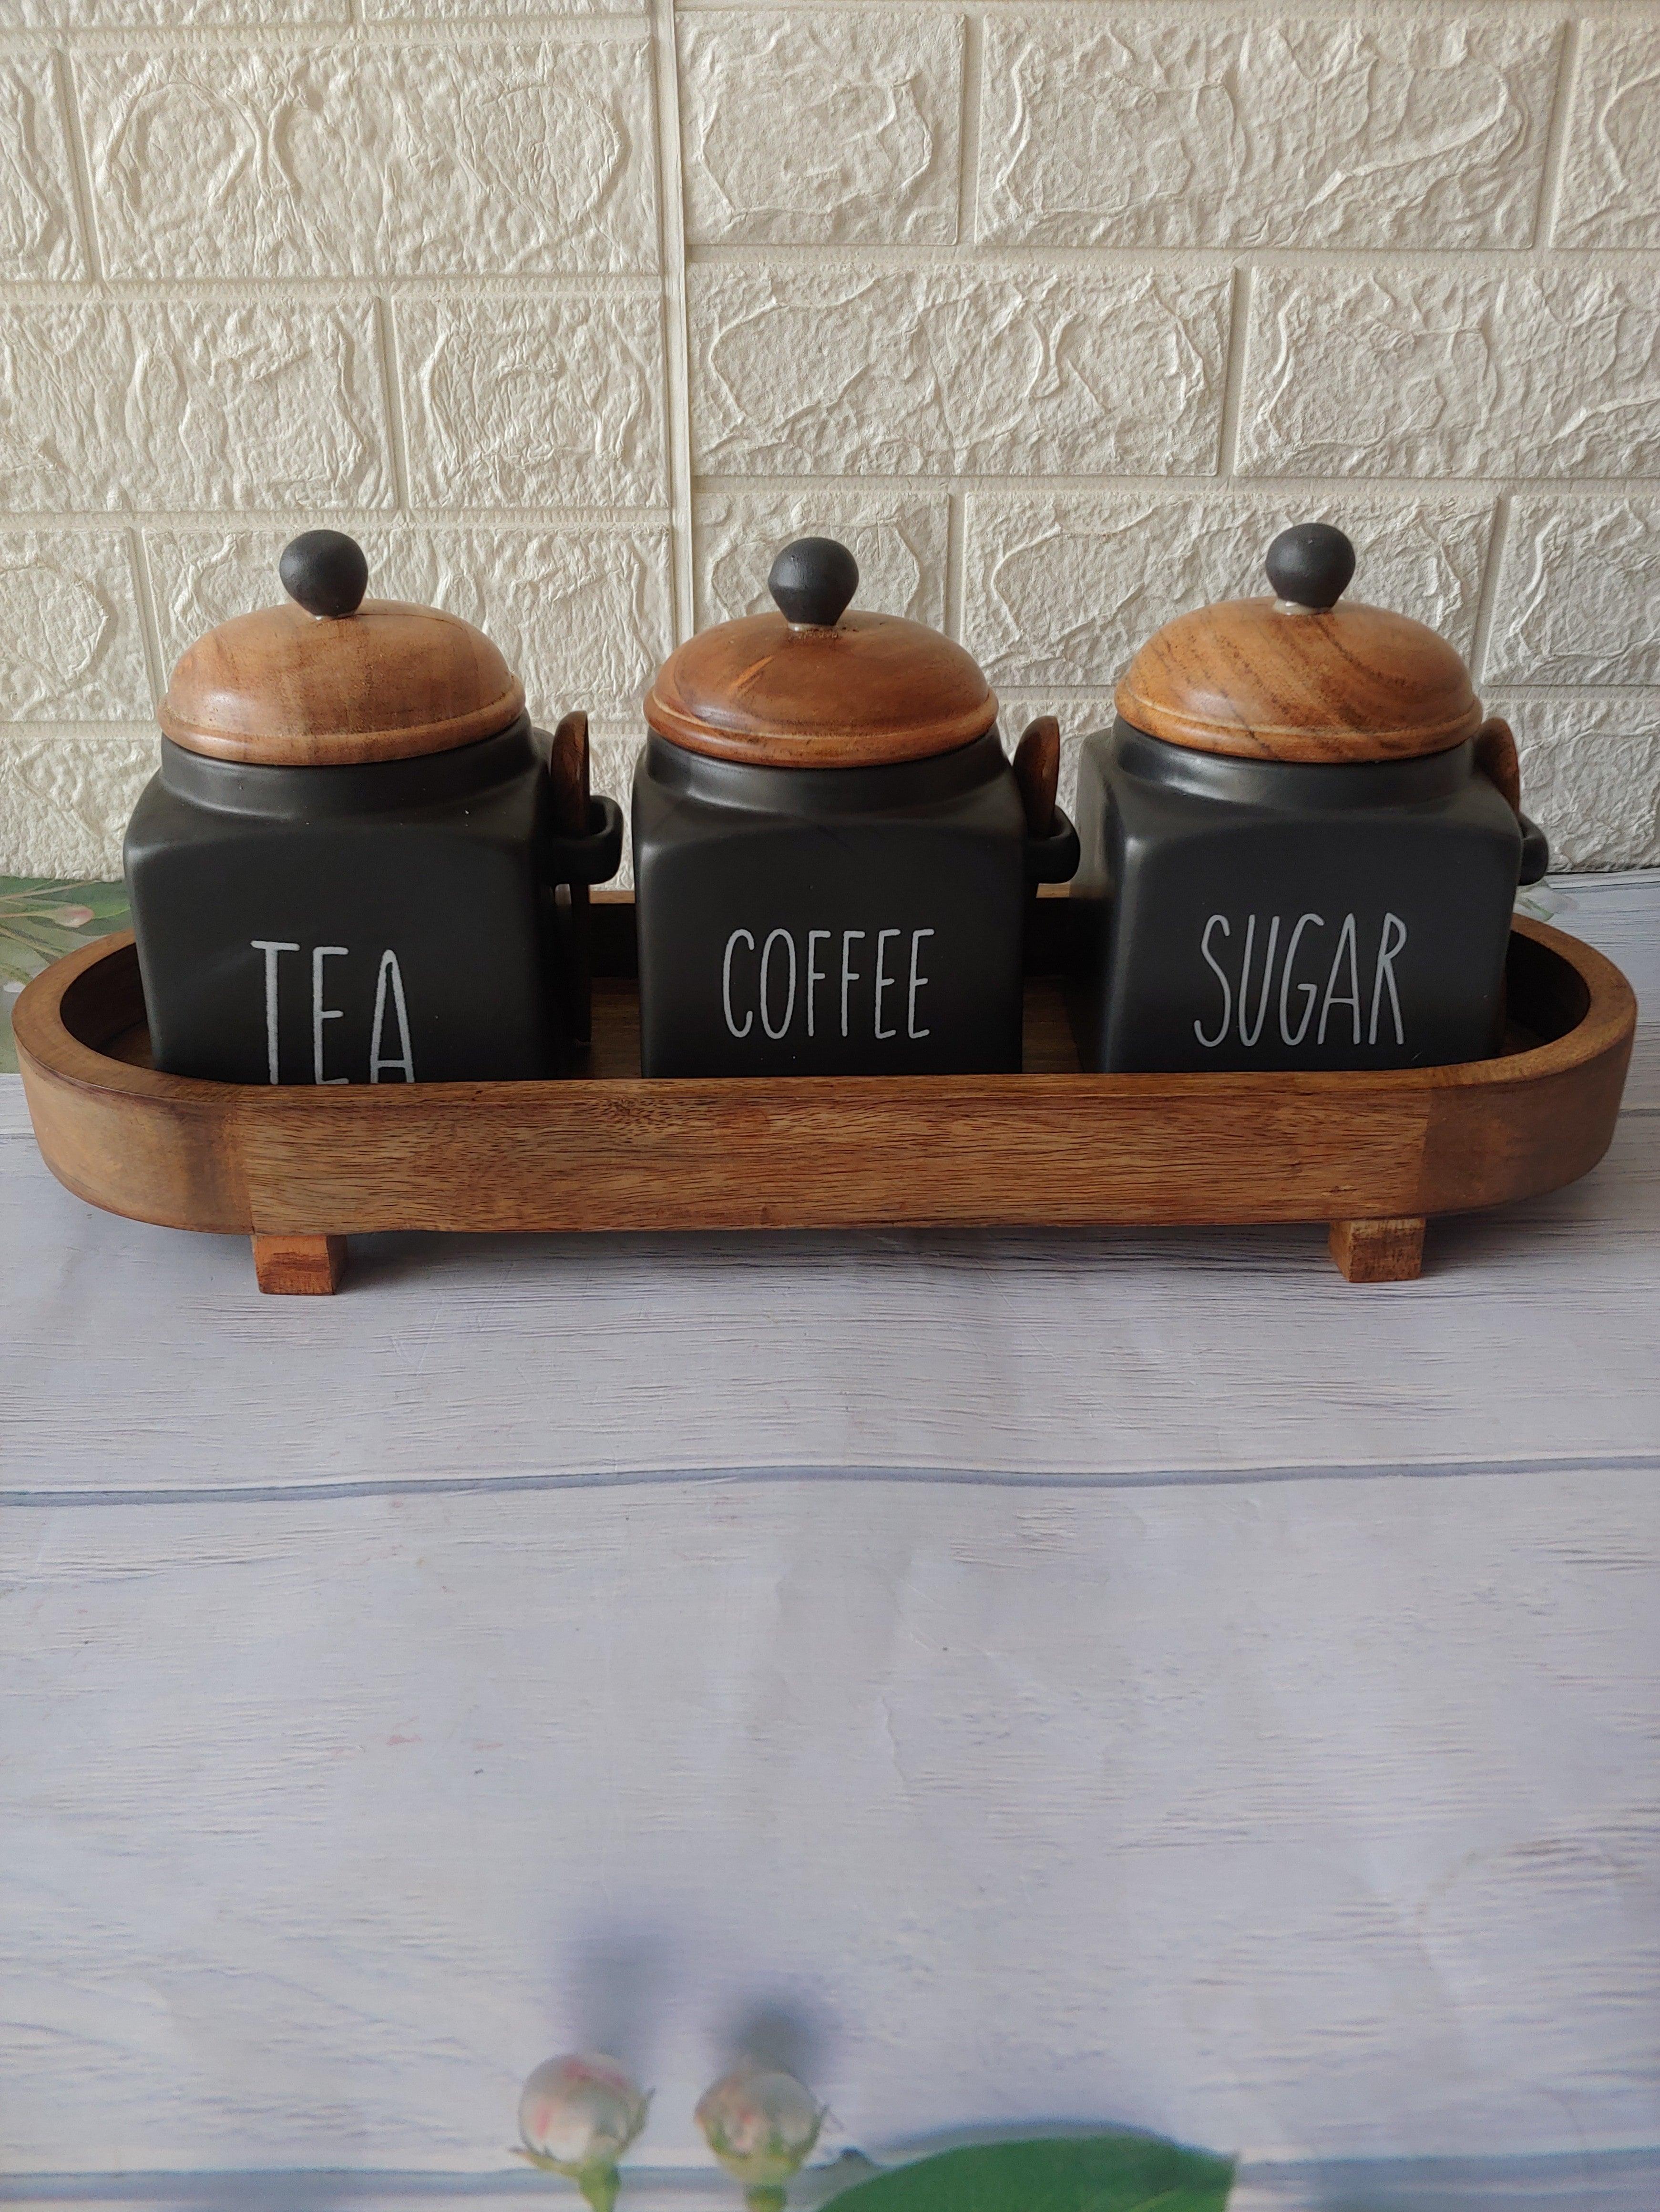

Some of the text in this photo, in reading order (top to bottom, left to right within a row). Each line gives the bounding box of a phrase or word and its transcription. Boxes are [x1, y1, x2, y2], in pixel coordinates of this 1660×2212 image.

[250, 940, 414, 1084] TEA
[723, 928, 935, 1039] COFFEE
[1194, 913, 1407, 1047] SUGAR
